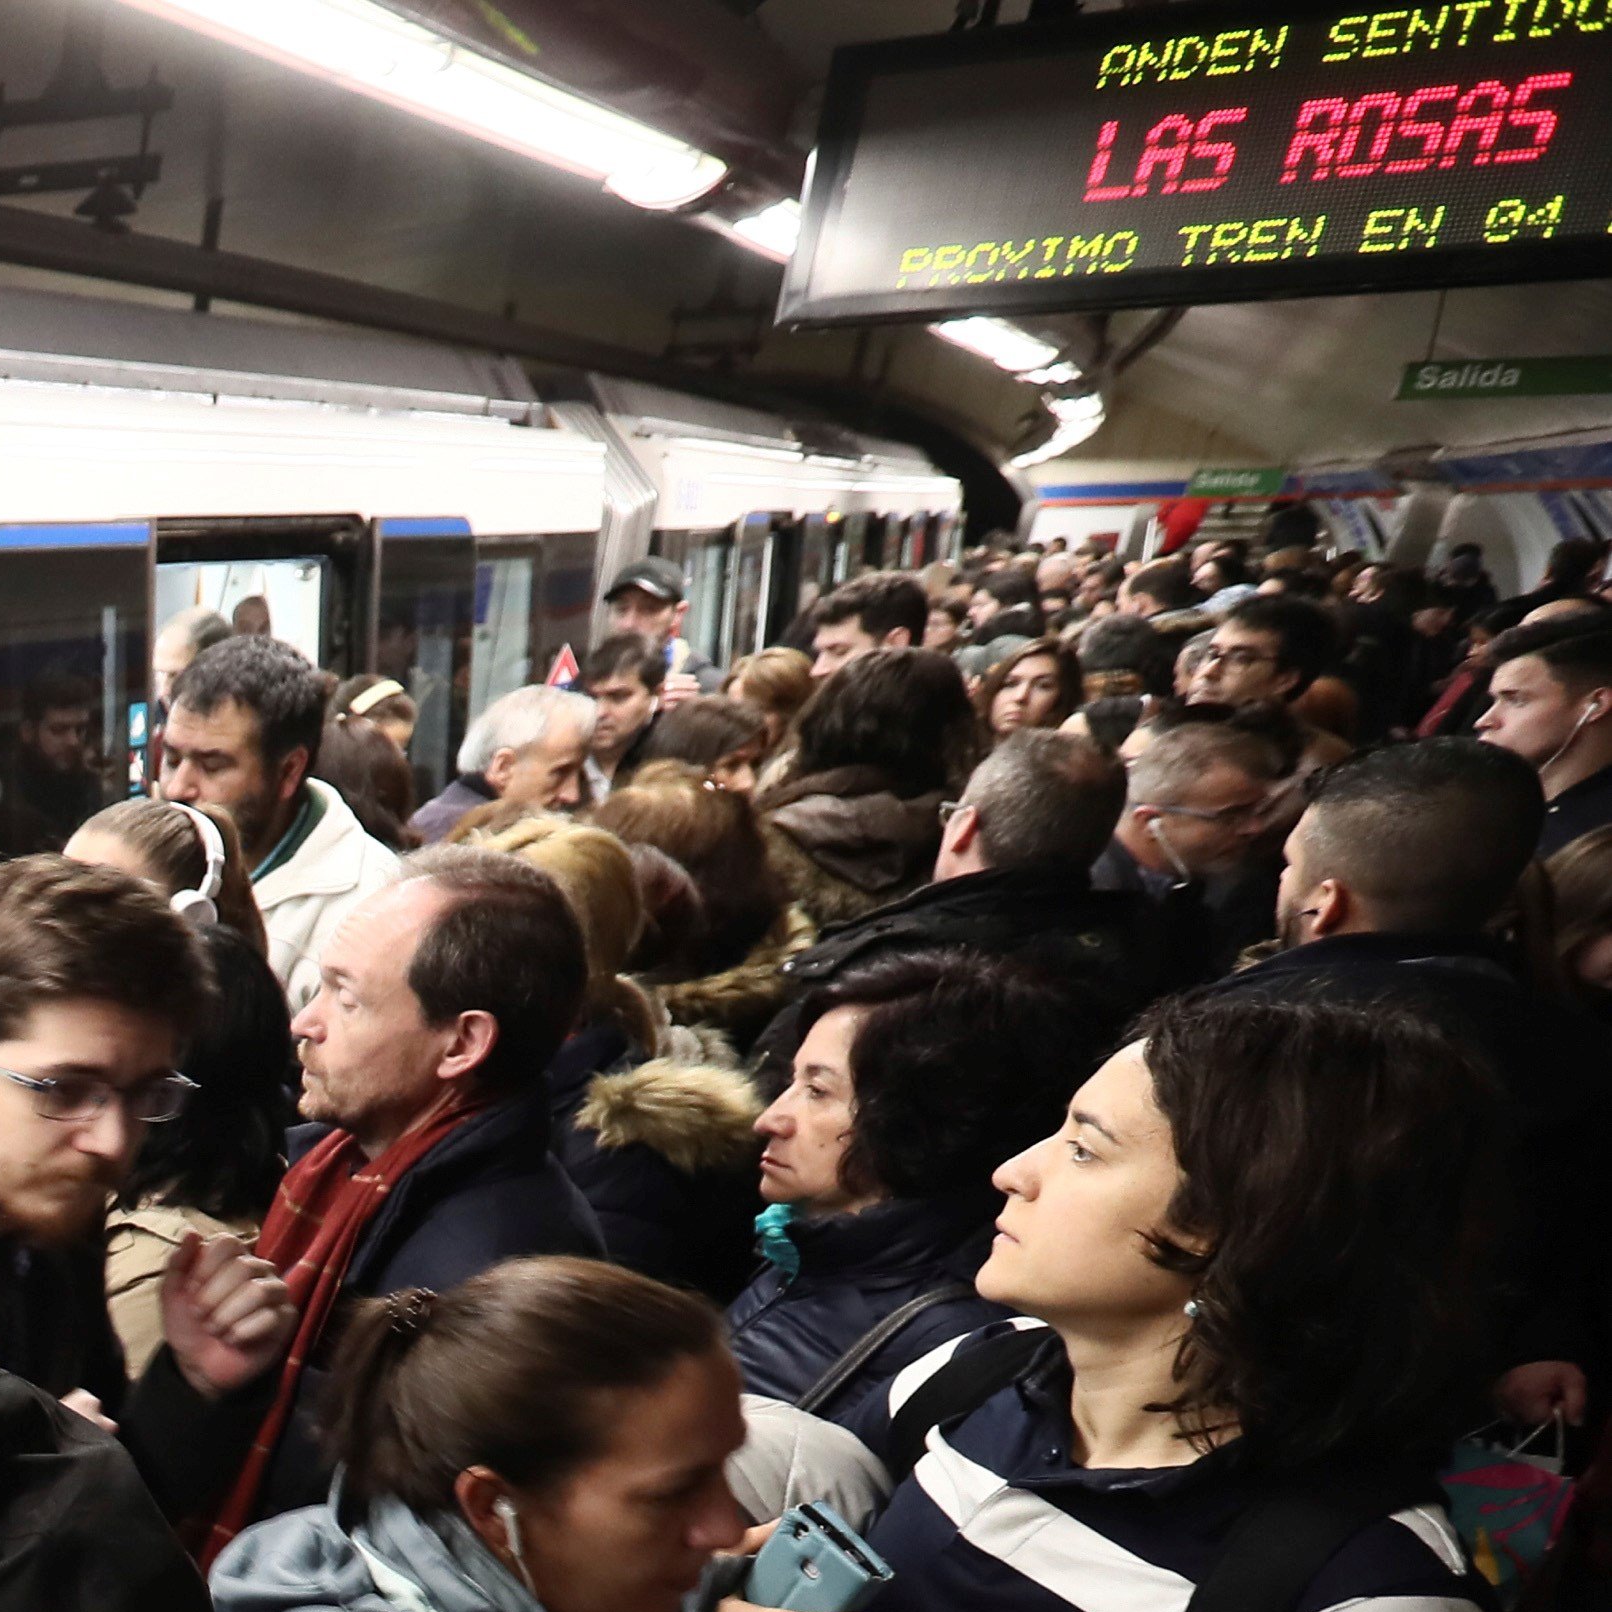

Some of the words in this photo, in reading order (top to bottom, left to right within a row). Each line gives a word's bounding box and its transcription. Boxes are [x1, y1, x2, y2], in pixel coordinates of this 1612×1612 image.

[1097, 26, 1289, 89] ANDEN
[1083, 107, 1249, 203] LAS
[1279, 72, 1574, 185] ROSAS
[895, 230, 1139, 288] PROXIMO
[1178, 220, 1326, 268] TREN
[1358, 205, 1446, 254] EN
[1484, 195, 1564, 244] 04
[1414, 362, 1522, 390] Salida
